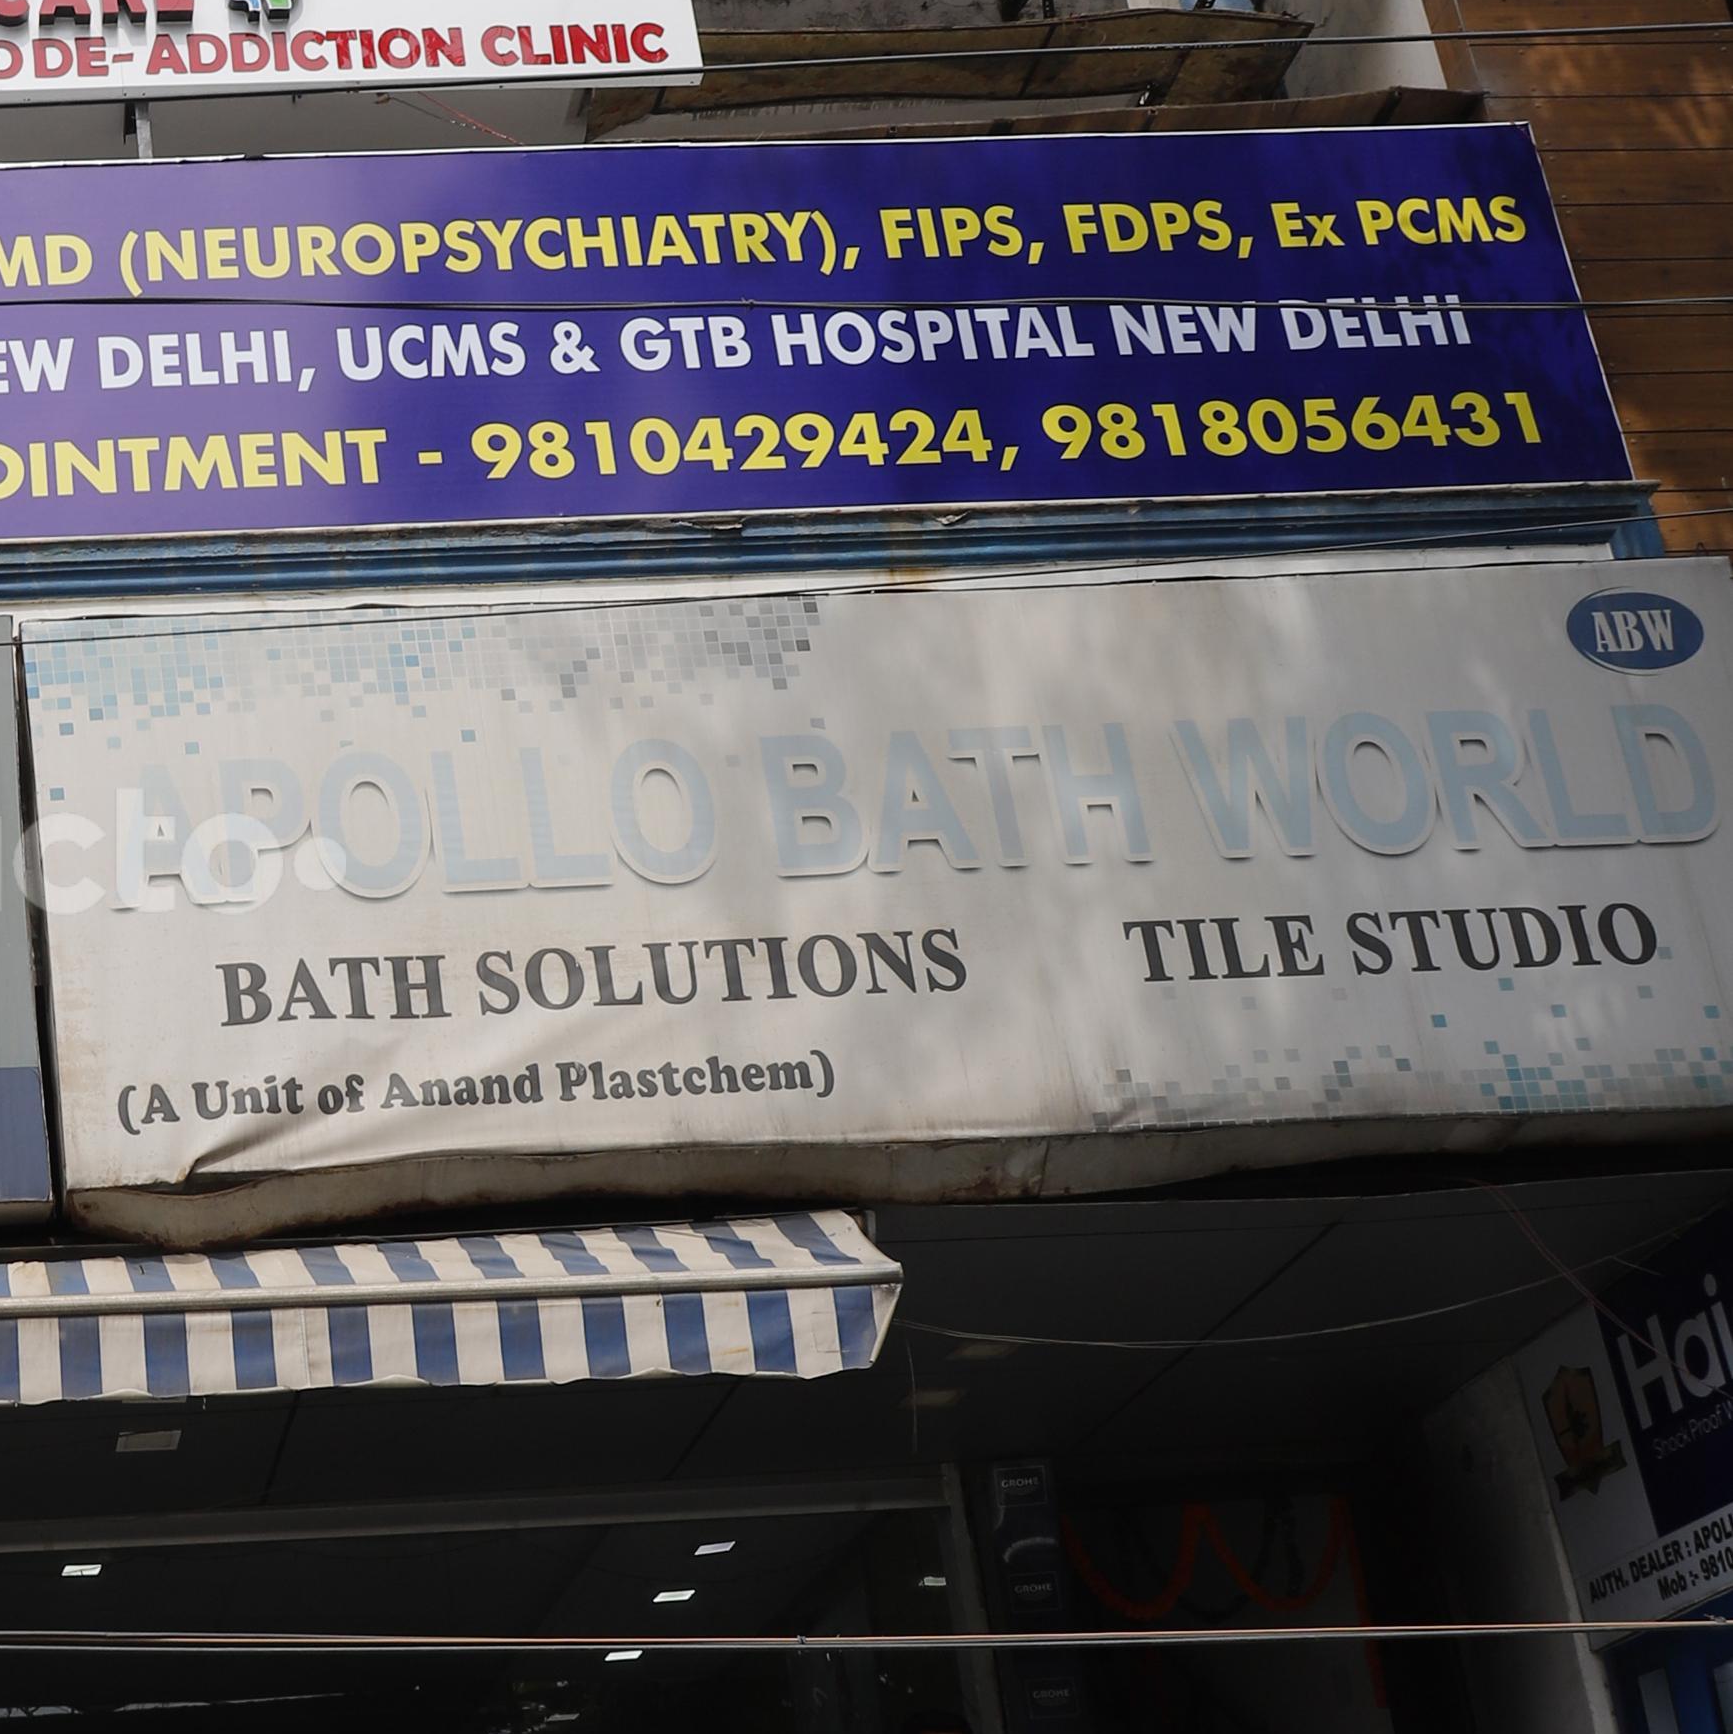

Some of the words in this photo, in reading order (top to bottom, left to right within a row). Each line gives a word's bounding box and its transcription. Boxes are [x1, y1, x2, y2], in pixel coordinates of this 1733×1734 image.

[481, 22, 668, 65] CLINIC
[119, 211, 863, 296] (NEUROPSYCHIATRY),
[880, 206, 1046, 266] FIPS,
[1063, 200, 1255, 261] FDPS,
[1272, 203, 1341, 250] Ex
[1361, 194, 1527, 247] PCMS
[99, 329, 316, 392] DELHI,
[336, 322, 526, 382] UCMS
[549, 320, 601, 372] &
[619, 306, 751, 372] GTB
[773, 304, 1094, 367] HOSPITAL
[1109, 301, 1259, 357] NEW
[1282, 294, 1472, 350] DELHI
[470, 407, 1019, 480] 9810429424,
[1042, 392, 1542, 462] 9818056431
[1595, 609, 1673, 653] ABW
[114, 737, 718, 910] APOLLO
[760, 717, 1154, 877] BATH
[1173, 702, 1721, 857] WORLD
[216, 954, 452, 1027] BATH
[477, 927, 968, 1017] SOLUTIONS
[1123, 915, 1324, 983] TILE
[1346, 902, 1657, 975] STUDIO
[193, 1076, 302, 1121] Unit
[318, 1076, 364, 1115] of
[380, 1064, 543, 1110] Anand
[555, 1050, 835, 1104] Plastchem)
[1014, 1582, 1053, 1594] GROHE
[1589, 1568, 1629, 1603] AUTH.
[1628, 1539, 1684, 1582] DEALER
